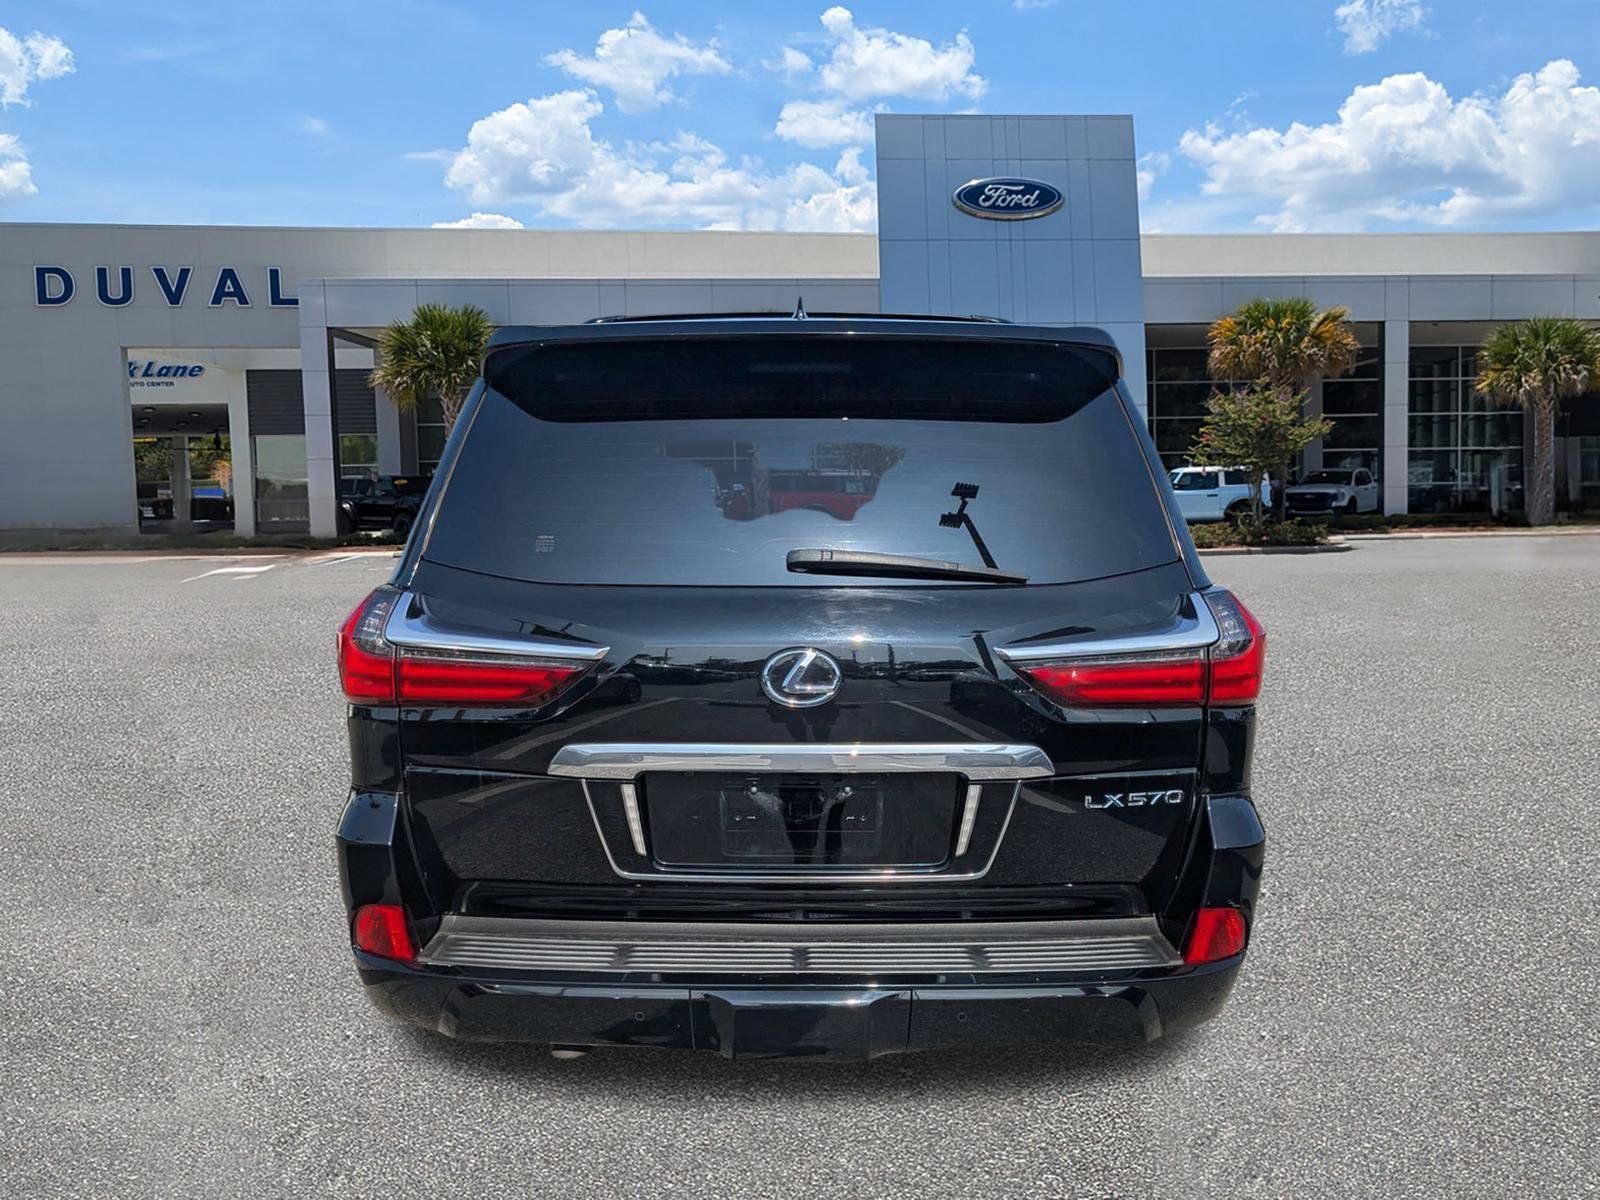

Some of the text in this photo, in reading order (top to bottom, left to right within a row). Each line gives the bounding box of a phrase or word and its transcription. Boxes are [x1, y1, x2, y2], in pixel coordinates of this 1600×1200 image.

[978, 185, 1040, 207] Ford
[33, 265, 299, 307] DUVAL
[141, 361, 204, 378] Lane
